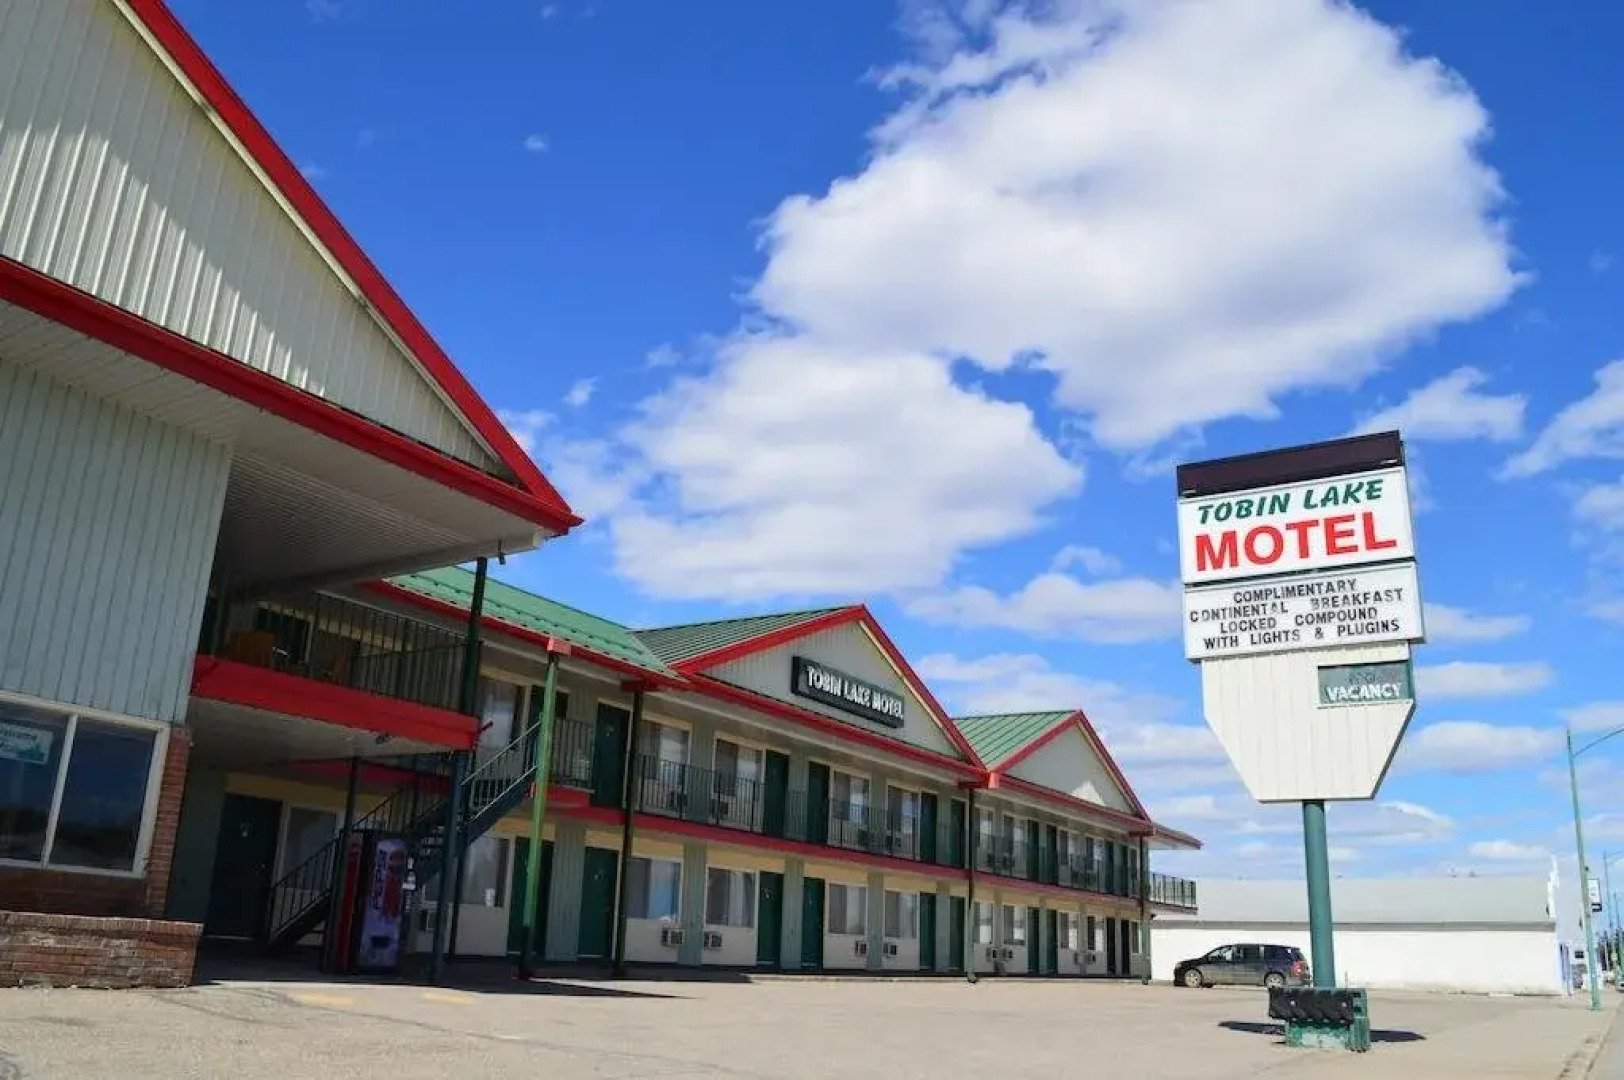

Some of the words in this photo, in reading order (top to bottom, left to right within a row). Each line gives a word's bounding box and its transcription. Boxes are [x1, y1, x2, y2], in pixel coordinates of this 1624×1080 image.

[1198, 492, 1290, 524] TOBIN
[1303, 479, 1384, 510] LAKE
[1195, 511, 1397, 571] MOTEL
[1233, 578, 1357, 604] COMPLIMENTARY
[1311, 588, 1404, 610] BREAKFAST
[1204, 636, 1240, 650] WITH
[1250, 629, 1300, 646] LIGHTS
[1314, 629, 1324, 640] &
[1337, 619, 1400, 637] PLUGINS
[1220, 617, 1277, 634] LOCKED
[1295, 607, 1378, 627] COMPOUND
[807, 666, 841, 696] TOBIN
[844, 681, 870, 706] LAKE
[872, 691, 903, 718] MOTEL
[1325, 682, 1402, 702] VACANCY
